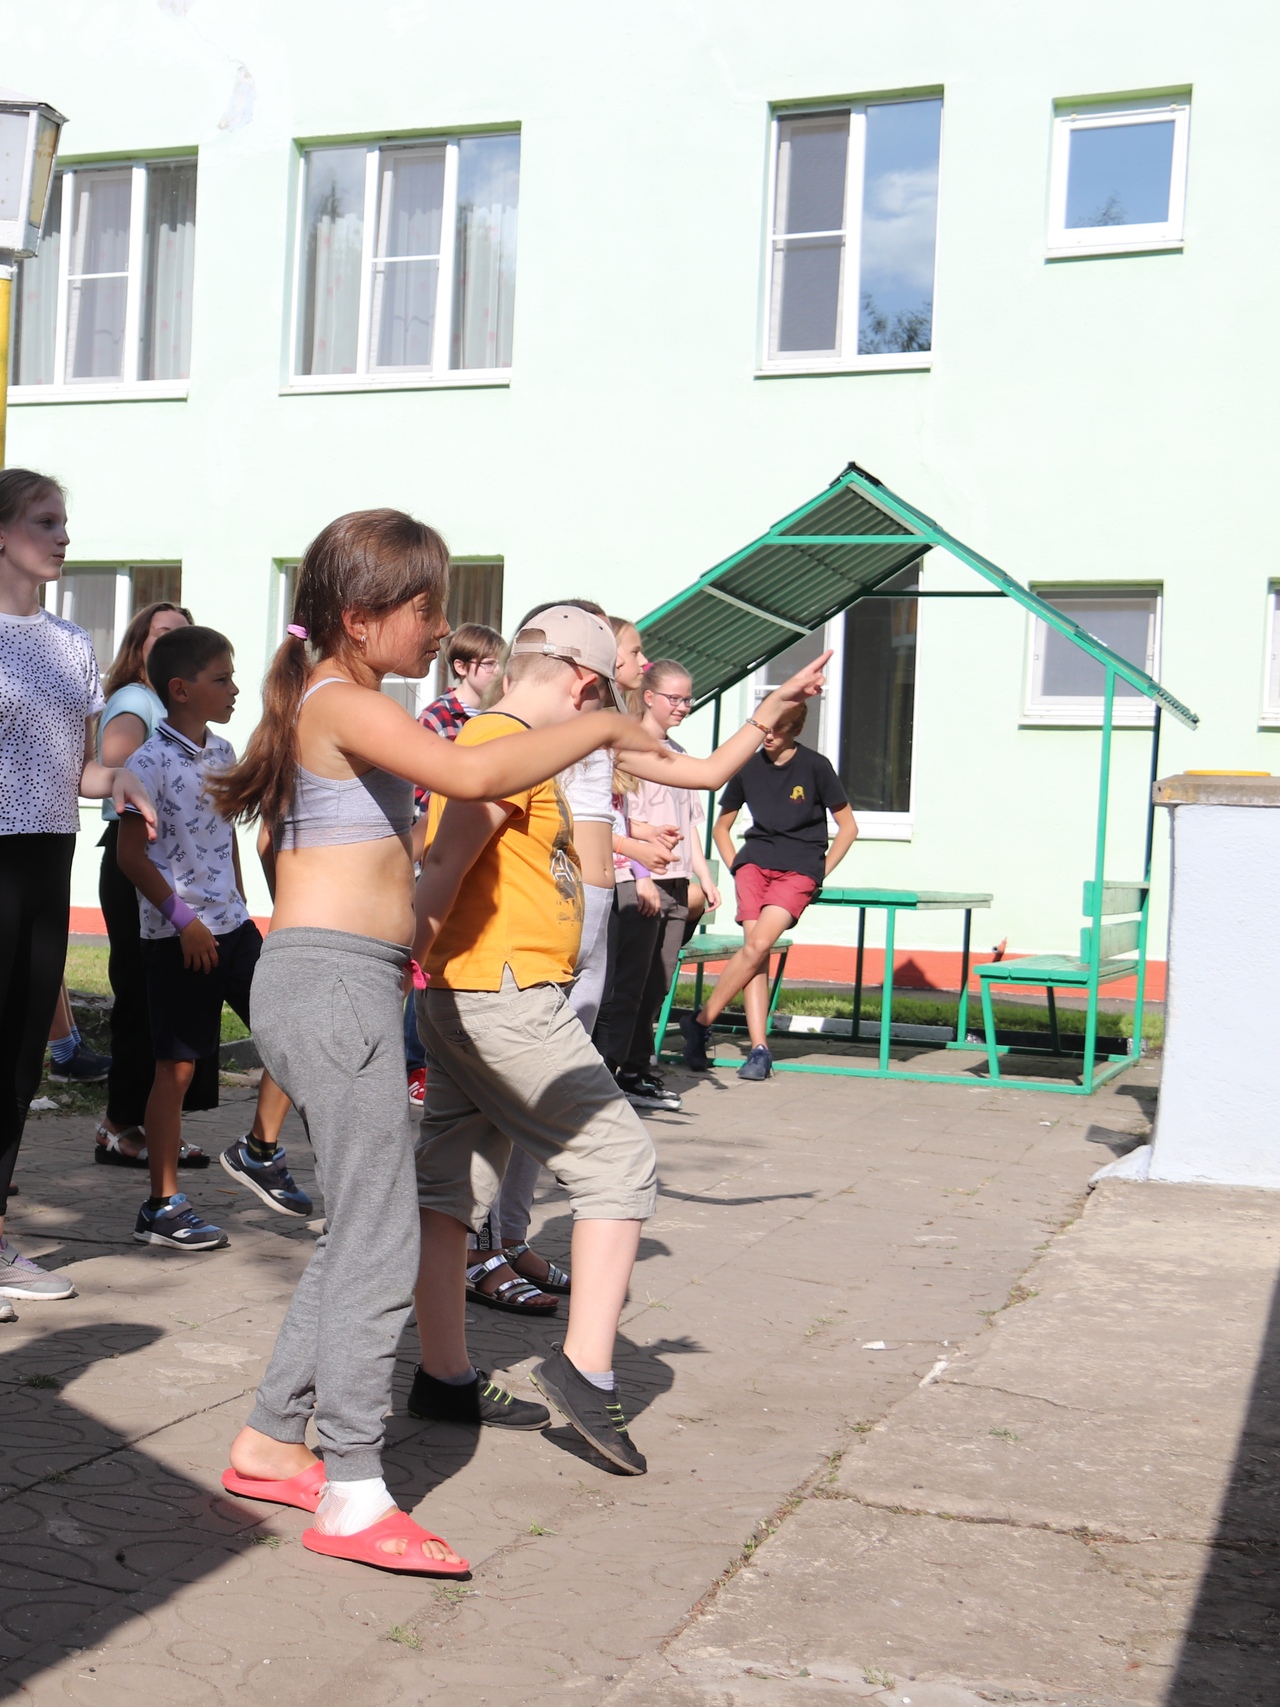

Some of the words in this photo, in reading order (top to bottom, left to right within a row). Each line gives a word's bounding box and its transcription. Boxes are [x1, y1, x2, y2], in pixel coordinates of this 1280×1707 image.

[137, 758, 149, 769] BOY
[174, 783, 186, 795] BOY
[162, 806, 175, 817] BOY
[189, 826, 199, 835] BOY
[209, 824, 218, 835] BOY
[175, 850, 186, 863] BOY
[218, 851, 230, 860] BOY
[183, 876, 196, 887] BOY
[207, 874, 217, 883] BOY
